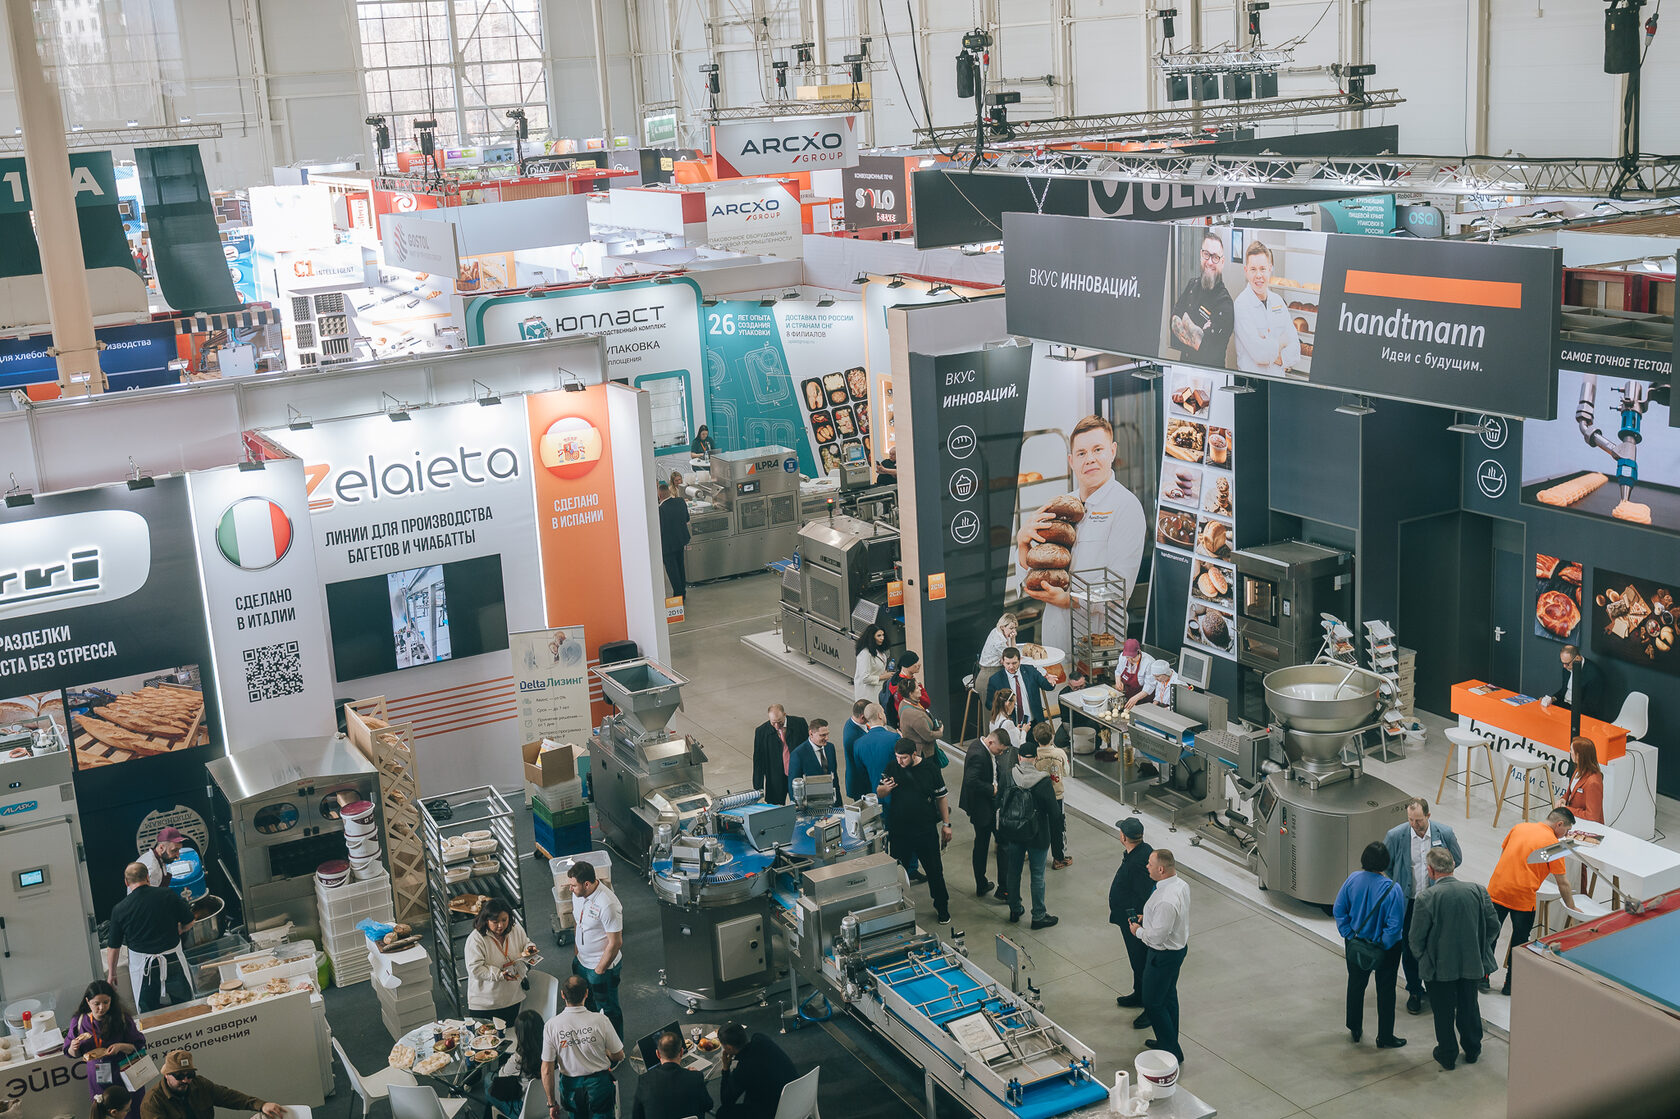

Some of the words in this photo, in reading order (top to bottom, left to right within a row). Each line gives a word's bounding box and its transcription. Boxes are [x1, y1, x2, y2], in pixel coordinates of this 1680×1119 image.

[741, 131, 842, 156] ARCXO
[802, 151, 843, 163] GROUP
[711, 199, 780, 217] ARCXO
[1029, 268, 1058, 288] ВКУС
[1060, 272, 1141, 299] ИННОВАЦИЙ.
[708, 313, 736, 336] 26
[737, 314, 749, 322] ЛЕТ
[749, 314, 771, 322] ОПЫТА
[785, 314, 817, 322] ДОСТАВКА
[1338, 302, 1485, 348] handtmann
[738, 329, 771, 337] УПАКОВКИ
[1381, 346, 1411, 363] Идеи
[1414, 353, 1421, 364] с
[1424, 352, 1483, 372] будущим.
[1560, 350, 1592, 363] САМОЕ
[1594, 354, 1631, 368] ТОЧНОЕ
[945, 369, 976, 386] ВКУС
[943, 383, 1019, 409] ИННОВАЦИЙ.
[755, 458, 779, 471] ILPRA
[554, 493, 599, 512] СДЕЛАНО
[325, 526, 368, 547] ЛИНИИ
[371, 520, 398, 540] ДЛЯ
[401, 506, 493, 534] ПРОИЗВОДСТВА
[552, 517, 559, 529] В
[560, 509, 604, 528] ИСПАНИИ
[348, 542, 400, 564] БАГЕТОВ
[403, 540, 411, 555] И
[413, 529, 476, 552] ЧИАБАТТЫ
[235, 588, 292, 611] СДЕЛАНО
[237, 617, 245, 631] В
[247, 607, 296, 629] ИТАЛИИ
[0, 657, 28, 677] СТА
[29, 652, 56, 671] БЕЗ
[58, 641, 117, 666] СТРЕССА
[196, 1029, 203, 1037] и
[207, 1014, 258, 1034] заварки
[559, 1026, 593, 1040] Service
